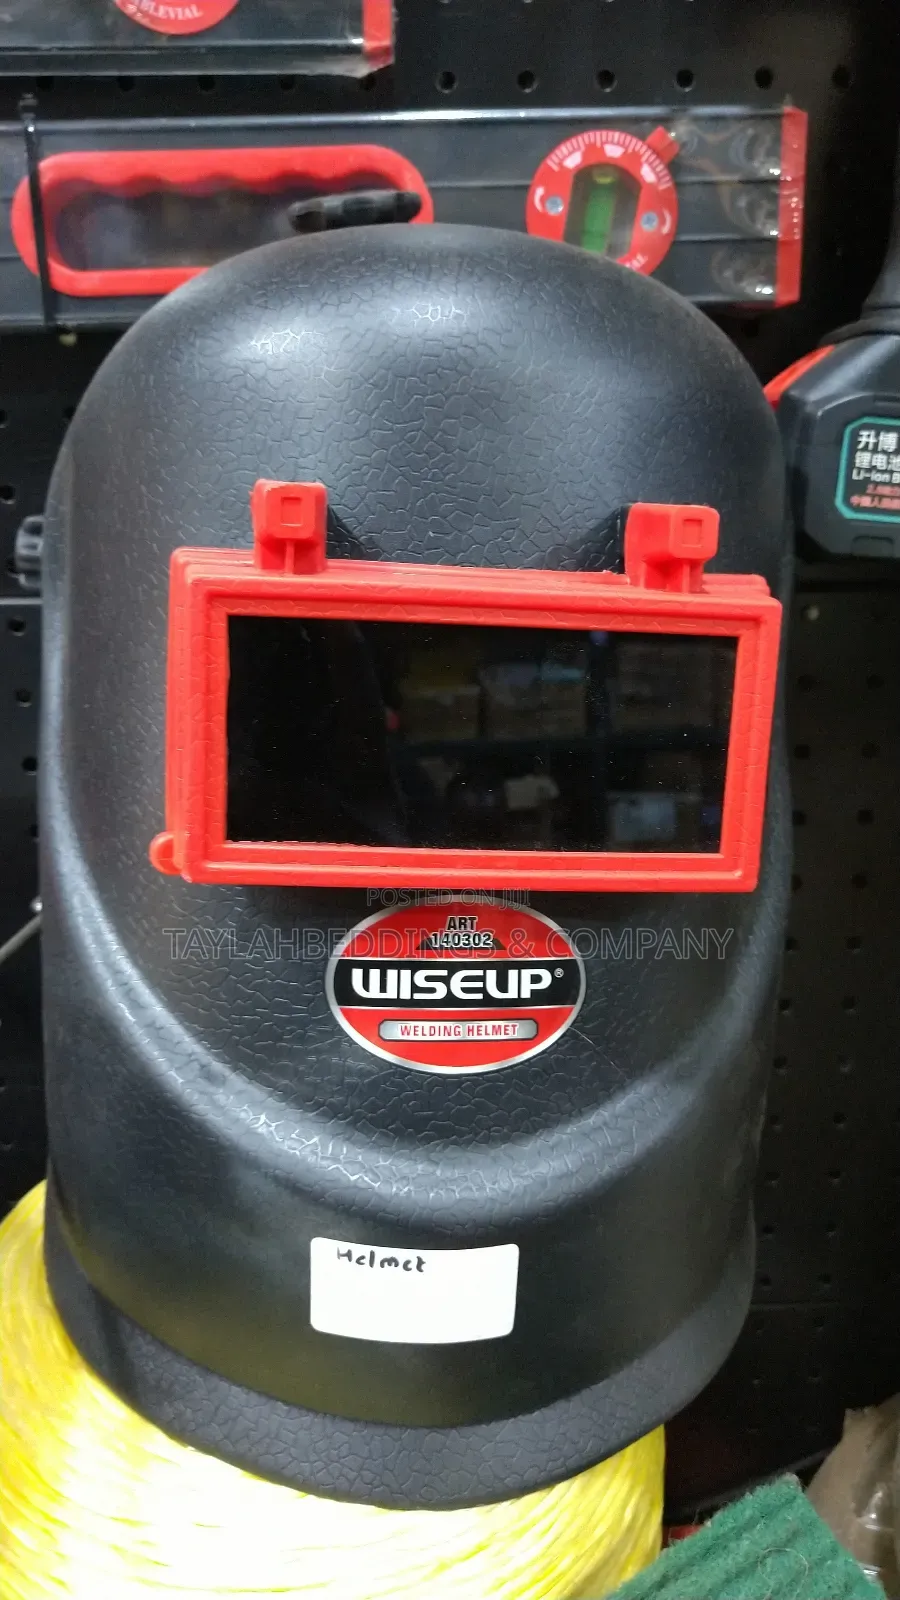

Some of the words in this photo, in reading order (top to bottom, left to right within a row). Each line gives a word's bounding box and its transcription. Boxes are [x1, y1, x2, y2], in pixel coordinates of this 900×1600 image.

[447, 915, 478, 932] ART
[430, 932, 493, 948] 140302
[399, 1023, 462, 1037] WELDING
[465, 1022, 519, 1037] HELMET
[336, 1246, 426, 1273] Helmet
